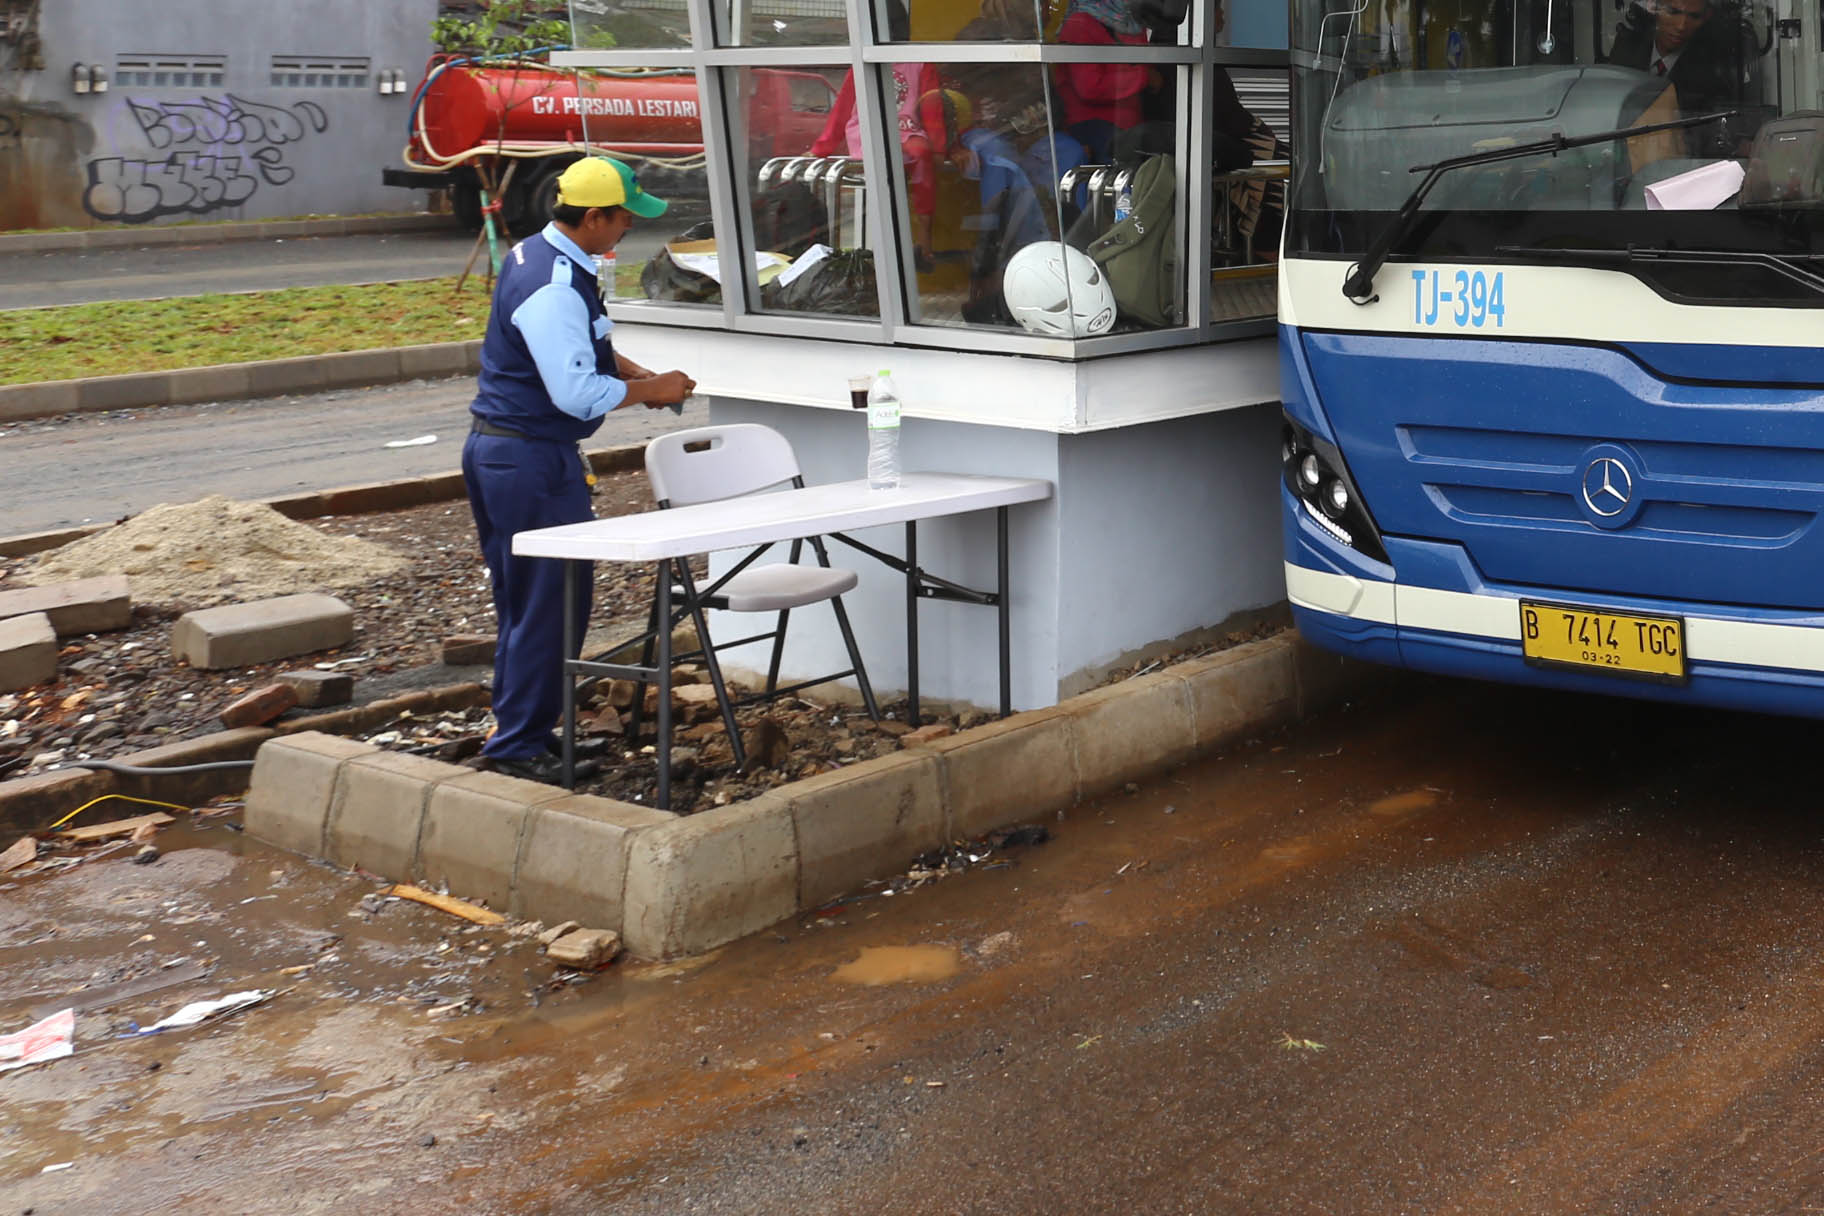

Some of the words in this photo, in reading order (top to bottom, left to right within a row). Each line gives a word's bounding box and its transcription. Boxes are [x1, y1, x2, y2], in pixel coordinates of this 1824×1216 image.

[532, 96, 559, 115] CV.
[563, 96, 634, 117] PERSADA
[638, 98, 698, 118] LESTARI
[1411, 270, 1505, 327] TJ-394
[1525, 610, 1539, 640] B
[1563, 614, 1618, 650] 7414
[1634, 622, 1677, 657] TGC
[1582, 651, 1621, 665] 03-22
